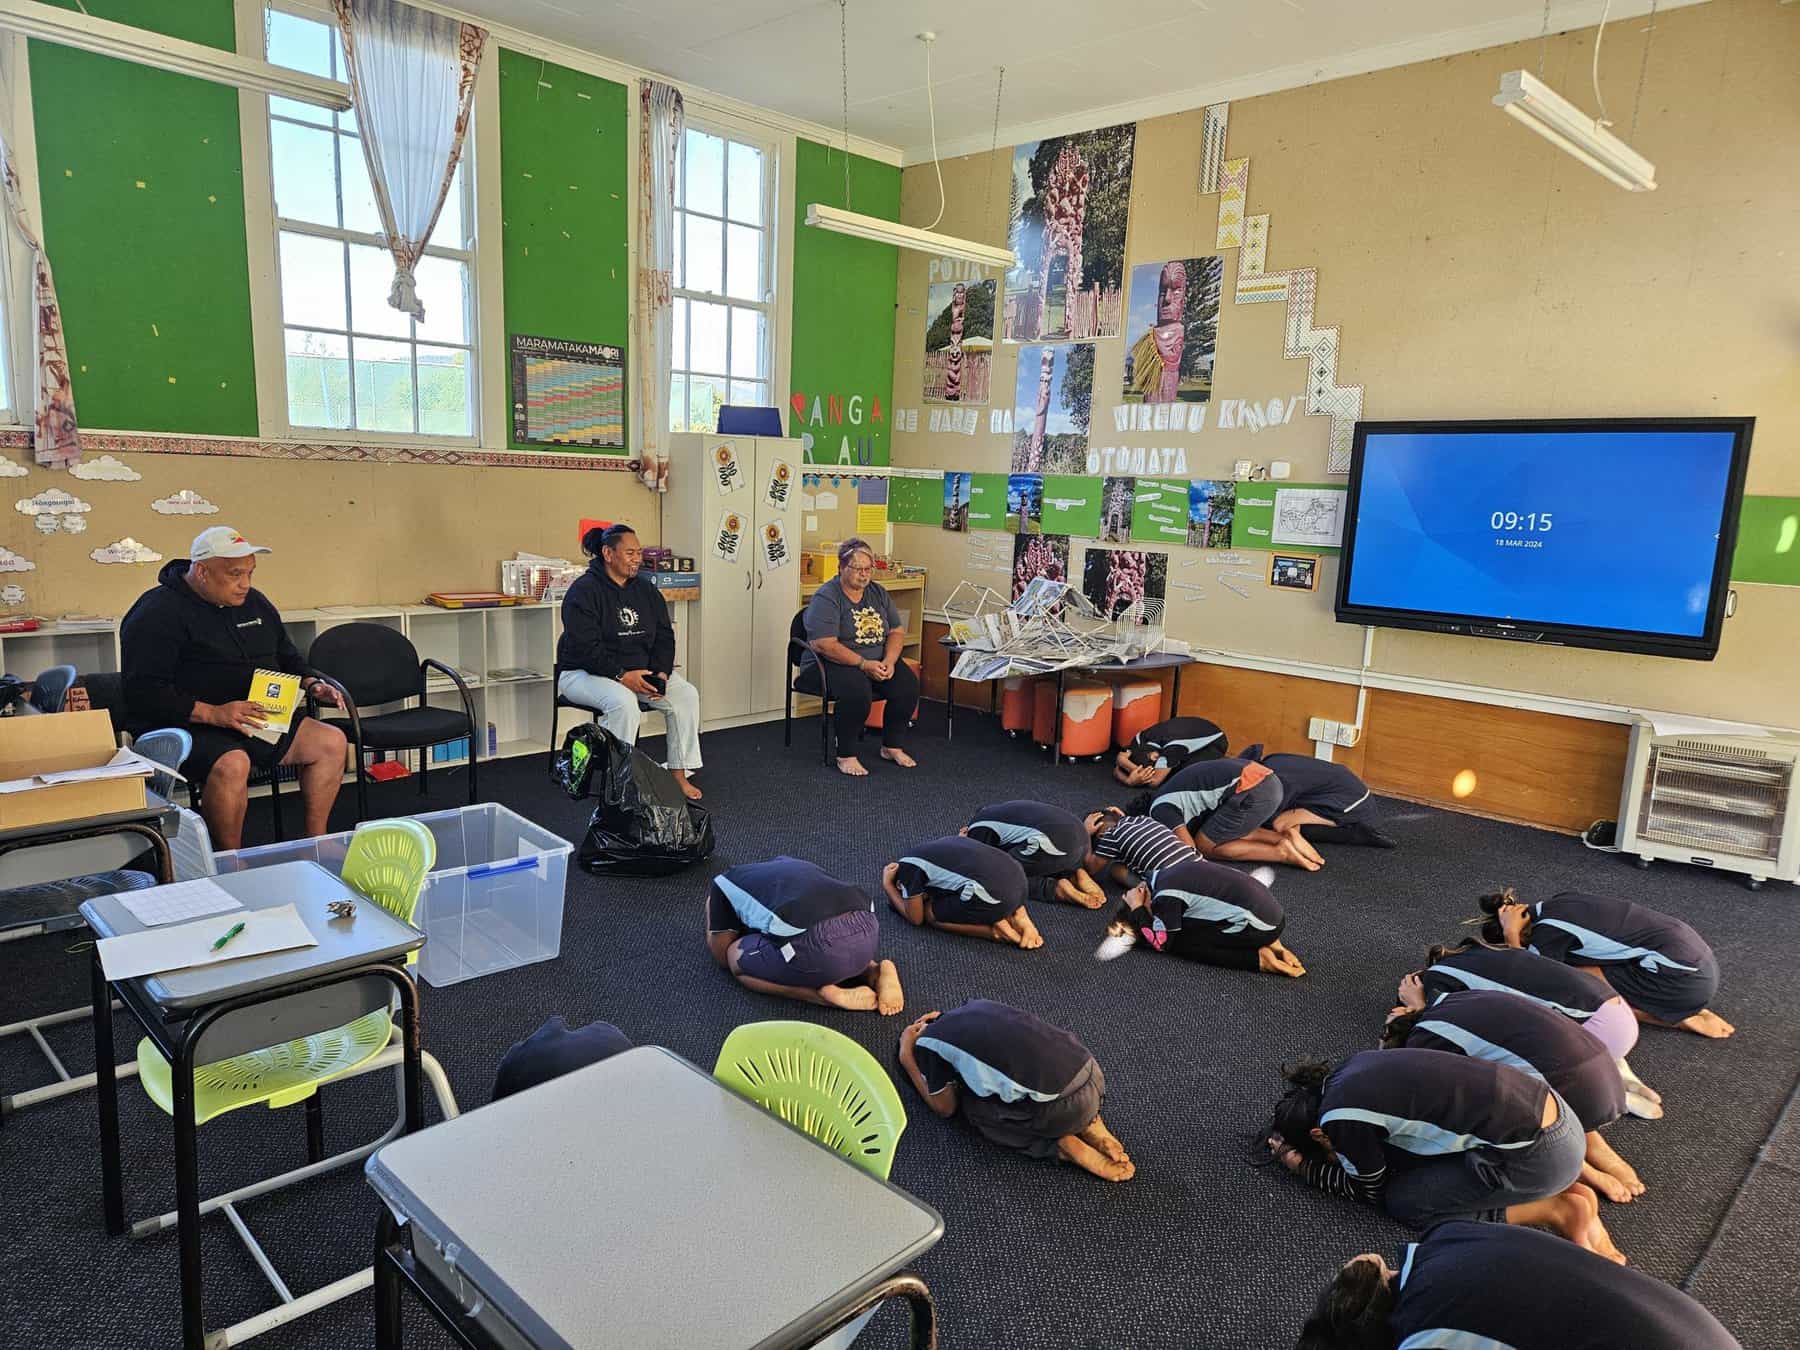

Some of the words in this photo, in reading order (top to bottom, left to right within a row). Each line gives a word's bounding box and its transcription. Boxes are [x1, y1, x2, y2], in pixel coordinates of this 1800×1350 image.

[790, 393, 884, 428] RANGA
[1113, 402, 1207, 433] WIREMU
[1491, 511, 1553, 532] 09:15
[1495, 538, 1505, 547] 18
[1505, 539, 1523, 548] MAR
[1524, 540, 1543, 549] 2024
